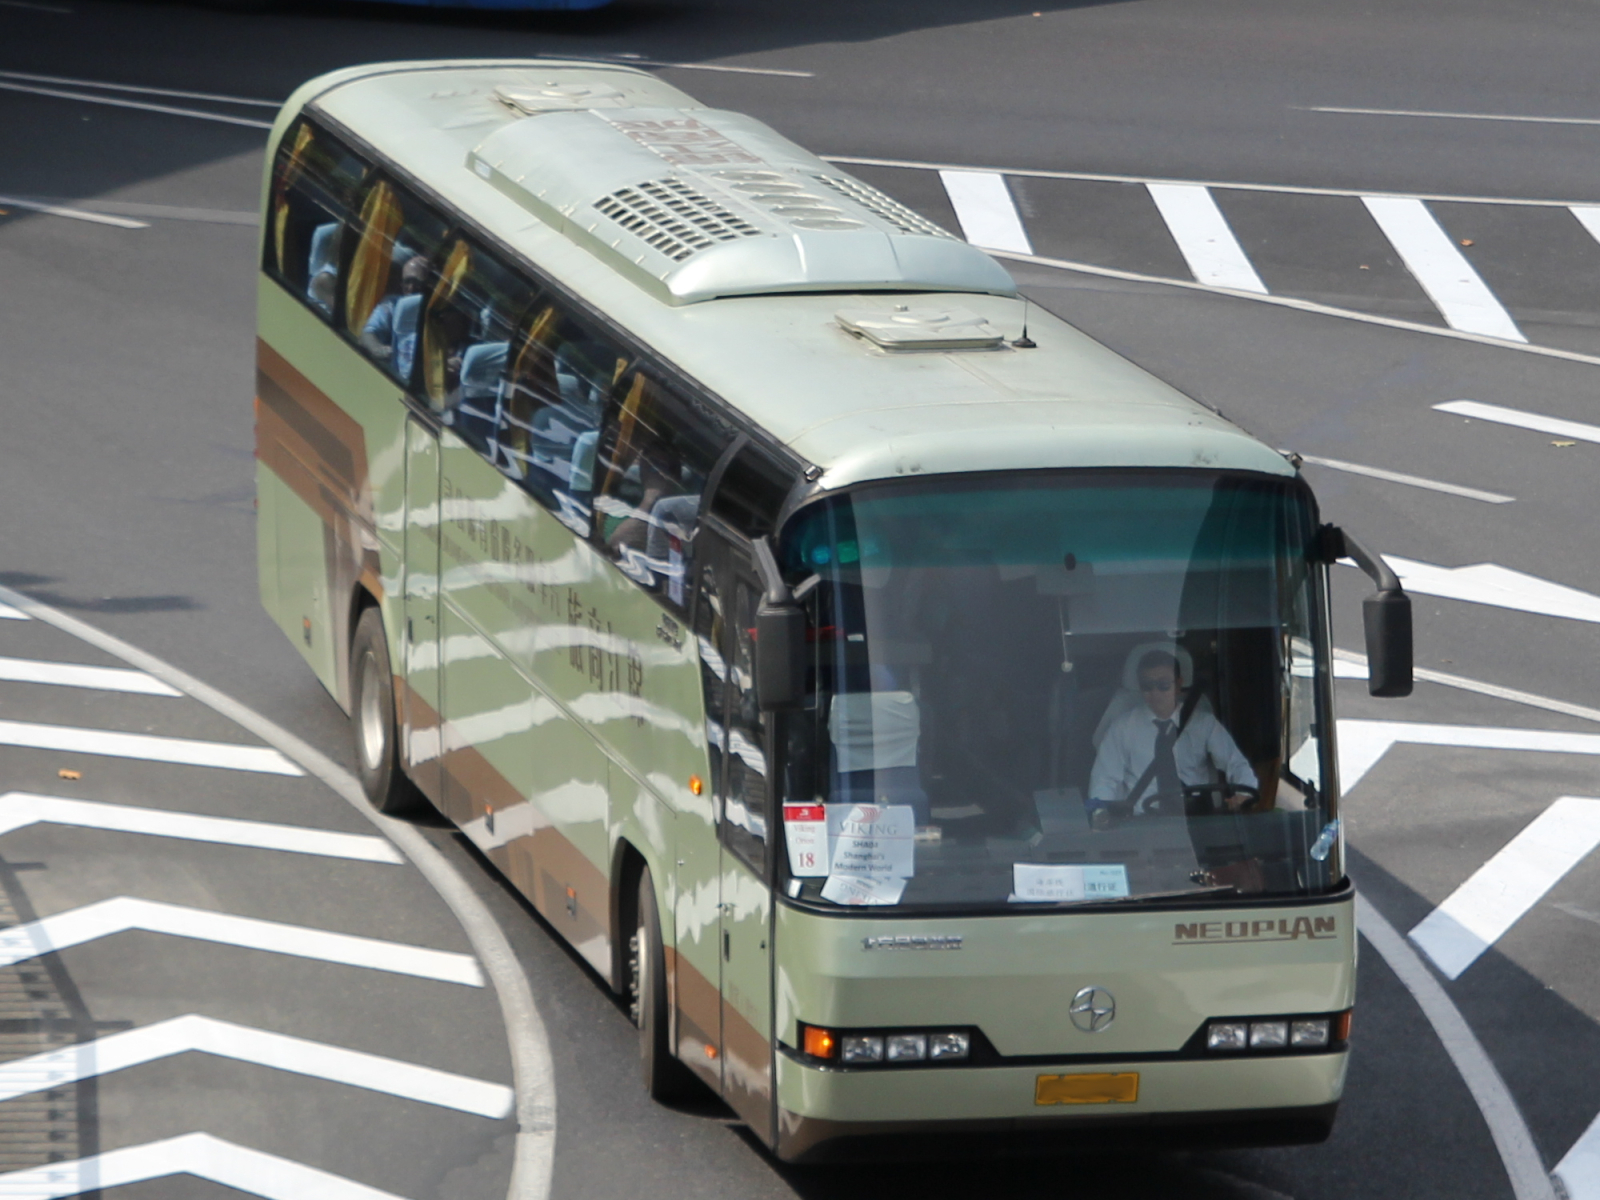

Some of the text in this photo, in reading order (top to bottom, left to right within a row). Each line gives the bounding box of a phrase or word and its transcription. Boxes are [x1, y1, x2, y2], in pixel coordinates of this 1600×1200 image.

[839, 821, 897, 836] VIKING
[798, 852, 815, 869] 18
[834, 862, 867, 872] Modern
[1174, 915, 1335, 940] NEOPLAN
